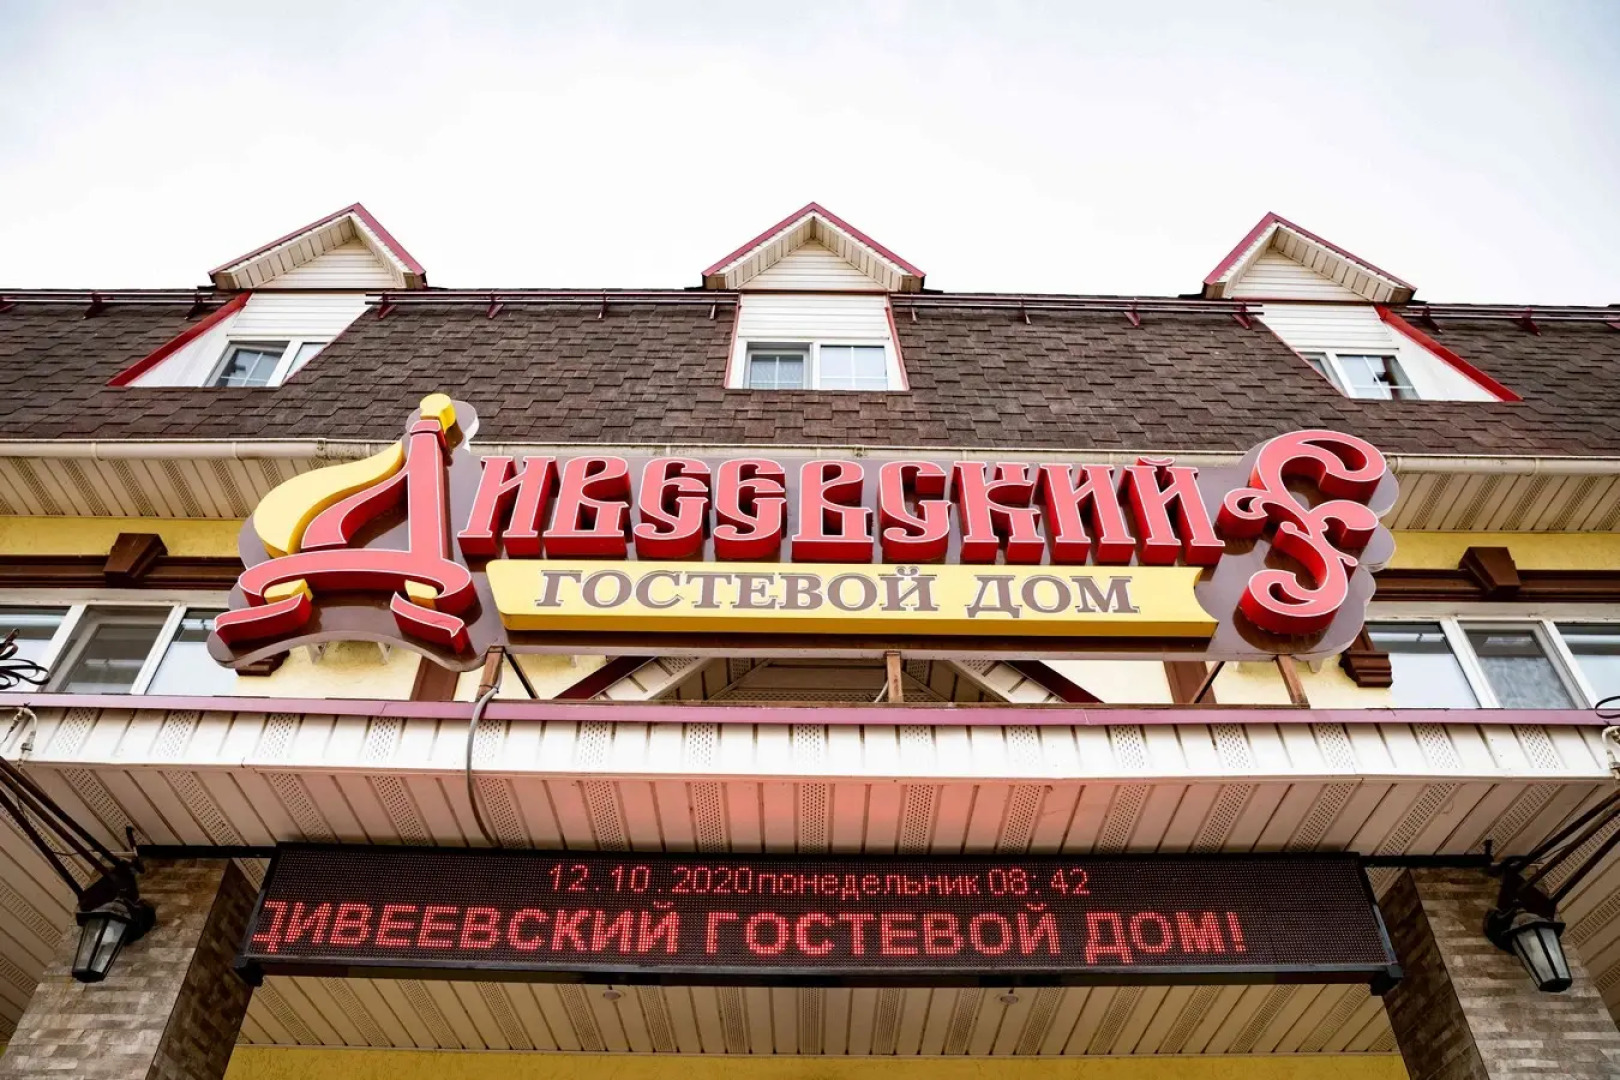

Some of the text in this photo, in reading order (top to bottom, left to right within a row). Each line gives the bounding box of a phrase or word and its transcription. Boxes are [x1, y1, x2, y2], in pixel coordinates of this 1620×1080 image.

[534, 566, 1140, 618] ГОСТЕВОЙ ДОМ
[705, 902, 1061, 955] ГОСТЕВОЙ
[1084, 910, 1247, 964] ДОМ!
